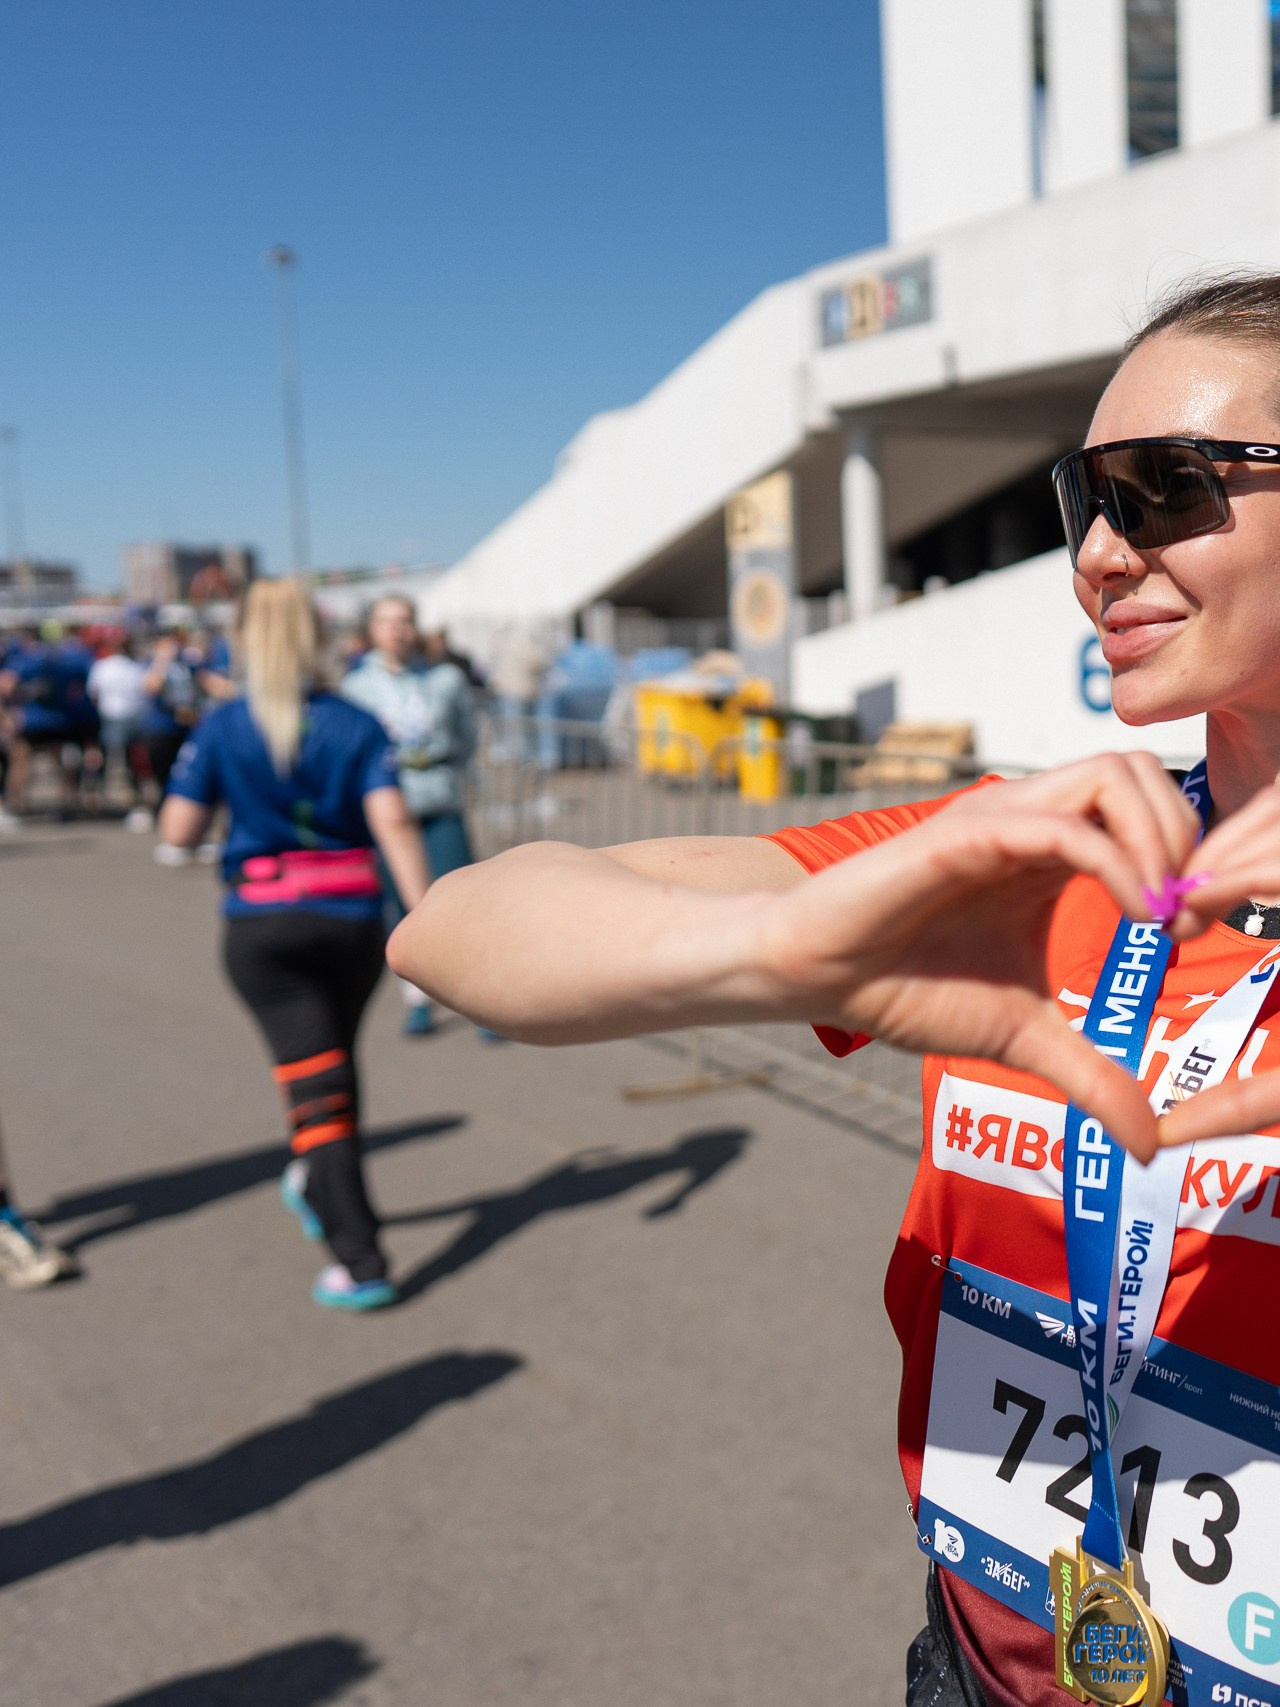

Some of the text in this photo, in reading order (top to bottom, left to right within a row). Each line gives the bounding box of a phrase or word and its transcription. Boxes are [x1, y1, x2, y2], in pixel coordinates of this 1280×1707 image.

[961, 1285, 1012, 1319] 10 КМ
[1077, 1298, 1098, 1389] КМ
[1229, 1392, 1270, 1416] НИЖНИЙ
[993, 1378, 1240, 1585] 7213
[1244, 1602, 1275, 1652] F
[1090, 1669, 1147, 1683] 10 ЛЕТ
